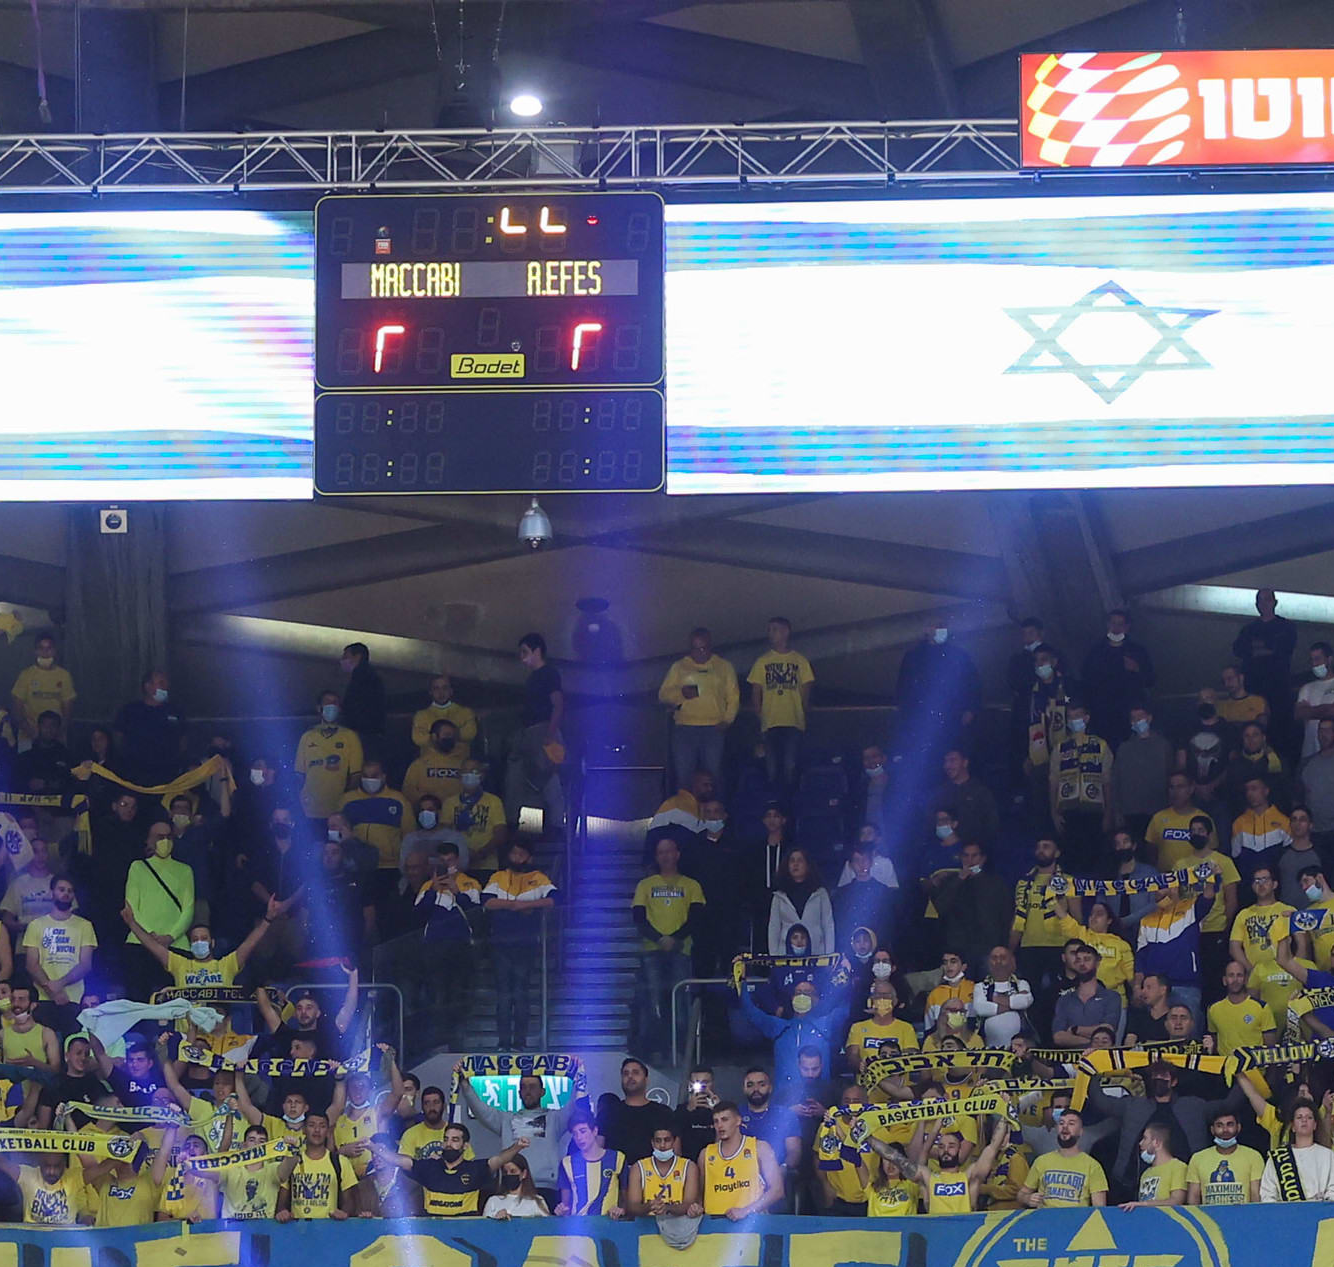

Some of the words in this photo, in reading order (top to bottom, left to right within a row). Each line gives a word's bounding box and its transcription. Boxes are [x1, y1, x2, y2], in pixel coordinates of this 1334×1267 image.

[370, 263, 461, 297] MACCABI
[527, 261, 602, 296] A.EFES
[455, 357, 521, 375] Bodet
[1164, 831, 1191, 841] FOX
[1074, 870, 1188, 894] MACCABI
[1250, 1044, 1315, 1065] YELLOW
[878, 1103, 959, 1125] BASKETBALL
[963, 1099, 997, 1115] CLUB
[63, 1138, 96, 1152] CLUB
[724, 1166, 737, 1179] 4
[1044, 1171, 1085, 1186] MACCABI
[714, 1180, 750, 1193] Playtika
[936, 1183, 965, 1195] FOX
[1013, 1237, 1048, 1252] THE
